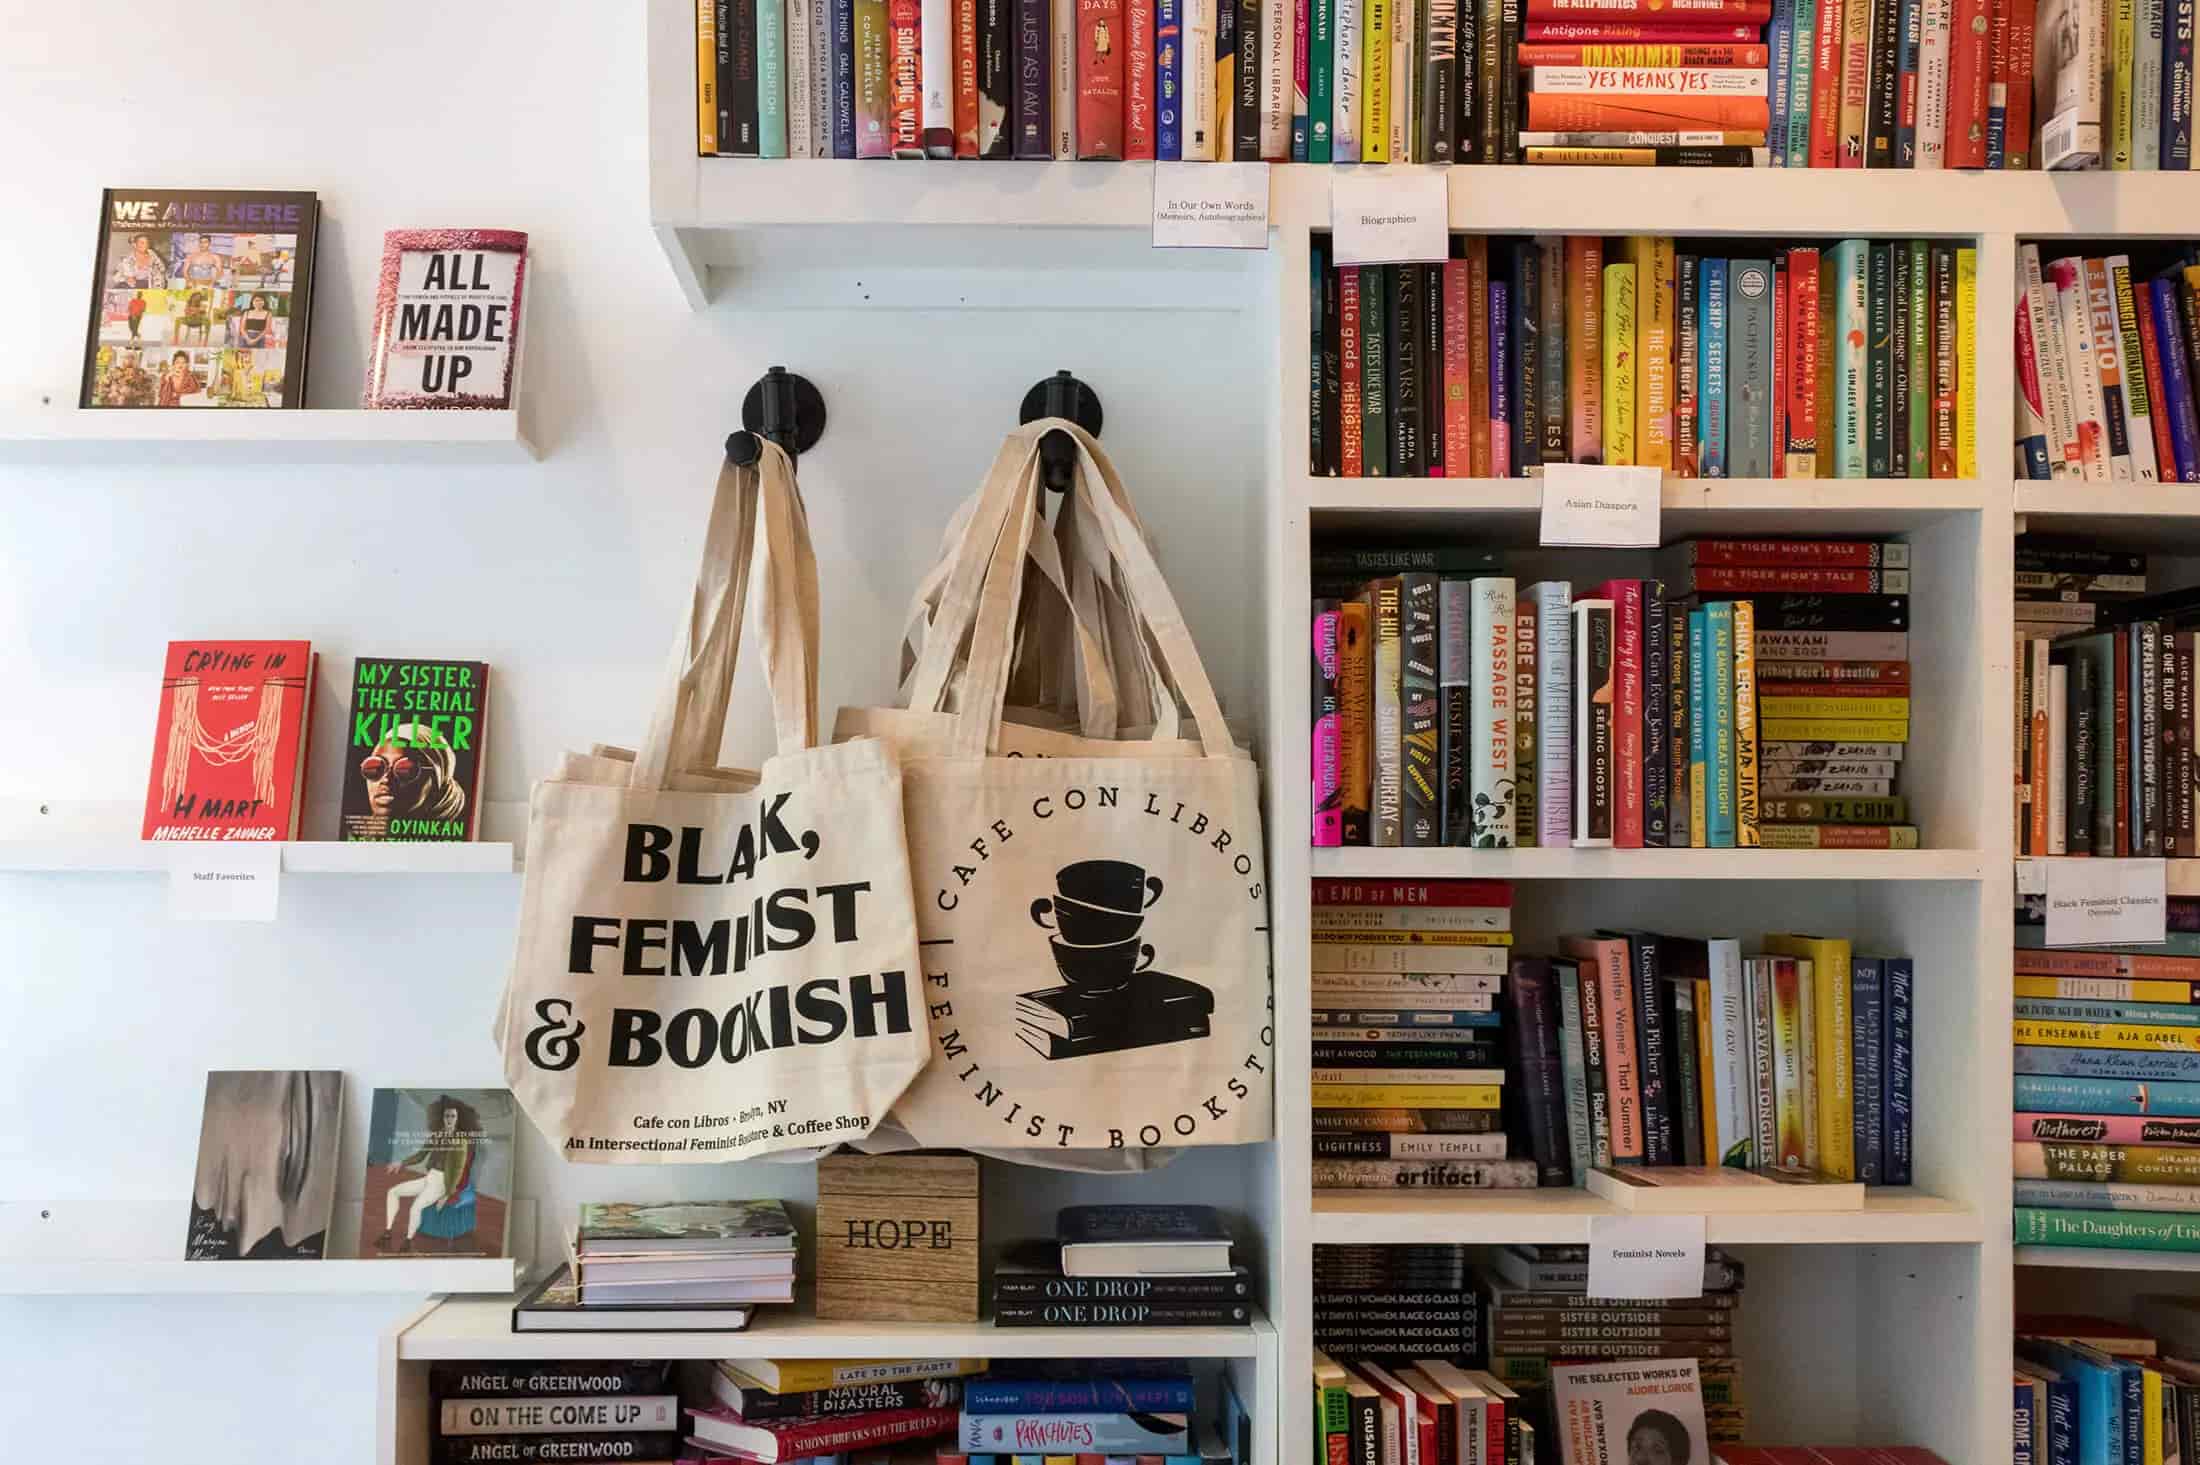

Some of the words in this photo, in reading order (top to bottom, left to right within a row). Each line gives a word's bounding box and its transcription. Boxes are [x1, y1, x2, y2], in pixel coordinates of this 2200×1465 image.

[1271, 2, 1282, 64] PERSONAL
[1542, 25, 1600, 40] Antigone
[1603, 25, 1641, 39] Rising
[839, 52, 849, 77] GAIL
[896, 27, 916, 103] SOMETHING
[1243, 30, 1255, 74] NICOLE
[1582, 46, 1681, 67] UNASHAMED
[1796, 30, 1811, 69] NANCY
[1587, 72, 1616, 89] YES
[1622, 71, 1676, 89] MEANS
[1679, 72, 1710, 92] YES
[1846, 41, 1866, 107] WOMEN
[1243, 76, 1255, 106] LYNN
[1270, 68, 1282, 131] LIBRARIAN
[1793, 73, 1809, 114] PELOSI
[2171, 60, 2184, 124] Steinhauer
[2182, 68, 2192, 118] Jennifer
[839, 81, 849, 135] CALDWELL
[899, 108, 916, 143] WILD
[1627, 132, 1677, 146] CONQUEST
[113, 201, 159, 220] WE
[163, 201, 218, 221] ARE
[227, 204, 300, 223] HERE
[1168, 200, 1178, 210] In
[1180, 200, 1197, 210] Our
[1200, 200, 1221, 210] Own
[1224, 200, 1255, 210] Words
[1361, 214, 1417, 226] Biographies
[423, 254, 490, 290] ALL
[1807, 267, 1818, 293] THE
[1343, 273, 1359, 322] little
[1708, 279, 1723, 329] KINSHIP
[399, 304, 507, 341] MADE
[1806, 300, 1817, 337] TIGER
[1340, 327, 1358, 370] gods
[1366, 332, 1382, 367] TASTES
[1647, 328, 1665, 352] THE
[422, 355, 472, 393] UP
[1366, 368, 1382, 391] LIKE
[1708, 342, 1722, 395] SECRETS
[1804, 343, 1815, 385] MOM'S
[1367, 390, 1382, 415] WAR
[1647, 361, 1665, 414] READING
[1343, 381, 1356, 426] MENG
[1804, 392, 1814, 423] TALE
[1343, 431, 1357, 459] JIN
[1647, 418, 1665, 446] LIST
[1565, 499, 1592, 509] Asian
[1594, 500, 1638, 512] Diaspora
[1516, 615, 1534, 672] EDGE
[1715, 628, 1728, 651] AN
[1734, 608, 1751, 662] CHINA
[2162, 634, 2175, 650] OF
[183, 650, 255, 672] CRYING
[263, 652, 286, 669] IN
[359, 664, 391, 686] MY
[1491, 624, 1508, 710] PASSAGE
[2162, 652, 2175, 674] ONE
[1715, 651, 1728, 705] EMOTION
[357, 688, 397, 711] THE
[403, 690, 475, 712] SERIAL
[1516, 673, 1534, 723] CASE
[1735, 668, 1752, 731] DREAM
[2162, 677, 2175, 711] BLOOD
[353, 712, 473, 750] KILLER
[1595, 707, 1605, 754] SEEING
[1716, 708, 1728, 725] OF
[1491, 719, 1507, 772] WEST
[1716, 728, 1729, 767] GREAT
[1739, 739, 1753, 768] MA
[1595, 757, 1606, 808] GHOSTS
[1717, 768, 1729, 817] DELIGHT
[1739, 771, 1754, 814] JIAN
[173, 795, 195, 819] H
[199, 799, 263, 818] MART
[152, 826, 218, 840] MICHELLE
[222, 827, 276, 840] ZAUNER
[390, 819, 464, 836] OYINKAN
[937, 818, 1015, 912] CAFE
[1032, 787, 1119, 820] CON
[1143, 792, 1262, 900] LIBROS
[193, 871, 213, 881] Staff
[215, 871, 255, 881] Favorites
[568, 881, 871, 976] FEMIIST
[1640, 944, 1657, 1026] Rosamunde
[1583, 979, 1599, 1028] second
[524, 999, 586, 1072] &
[607, 971, 912, 1069] BOOKISH
[927, 971, 1075, 1147] FEMINIST
[1586, 1030, 1602, 1067] place
[1645, 1027, 1660, 1076] Pilcher
[1754, 1017, 1770, 1081] SAVAGE
[633, 1115, 664, 1129] Cafe
[667, 1117, 690, 1129] con
[694, 1115, 729, 1129] Libros
[767, 1100, 788, 1115] NY
[1759, 1086, 1773, 1164] TONGUES
[564, 1136, 585, 1149] An
[588, 1136, 687, 1151] Intersectional
[690, 1135, 737, 1151] Feminist
[772, 1124, 785, 1137] &
[787, 1120, 832, 1136] Coffee
[835, 1115, 870, 1131] Shop
[1319, 1142, 1383, 1152] LIGHTNESS
[1400, 1143, 1433, 1153] EMILY
[1439, 1143, 1482, 1153] TEMPLE
[2049, 1148, 2076, 1160] THE
[2083, 1149, 2128, 1161] PAPER
[2059, 1164, 2113, 1174] PALACE
[1395, 1166, 1482, 1185] artifact
[844, 1219, 952, 1250] HOPE
[2055, 1219, 2080, 1233] The
[2083, 1220, 2154, 1241] Daughters
[2158, 1223, 2173, 1240] of
[1612, 1248, 1652, 1259] Feminist
[1654, 1248, 1686, 1259] Novels
[1045, 1281, 1088, 1297] ONE
[1095, 1281, 1151, 1297] DROP
[1044, 1305, 1087, 1322] ONE
[1093, 1305, 1150, 1322] DROP
[1559, 1312, 1598, 1323] SISTER
[1601, 1312, 1661, 1323] OUTSIDER
[460, 1375, 509, 1391] ANGEL
[528, 1375, 622, 1391] GREENWOOD
[839, 1369, 869, 1381] LATE
[872, 1368, 888, 1377] TO
[892, 1366, 913, 1376] THE
[917, 1362, 953, 1373] PARTY
[1568, 1375, 1589, 1385] THE
[1590, 1372, 1640, 1384] SELECTED
[1642, 1369, 1678, 1381] WORKS
[1679, 1368, 1692, 1378] OF
[823, 1396, 904, 1411] DISASTERS
[828, 1384, 899, 1398] NATURAL
[1627, 1384, 1660, 1395] AUDRE
[1662, 1382, 1694, 1394] LORDE
[469, 1406, 502, 1426] ON
[506, 1406, 546, 1425] THE
[549, 1405, 607, 1425] COME
[614, 1406, 641, 1424] UP
[1015, 1418, 1093, 1449] PARACHUTES
[470, 1444, 519, 1460] ANGEL
[539, 1441, 633, 1458] GREENWOOD
